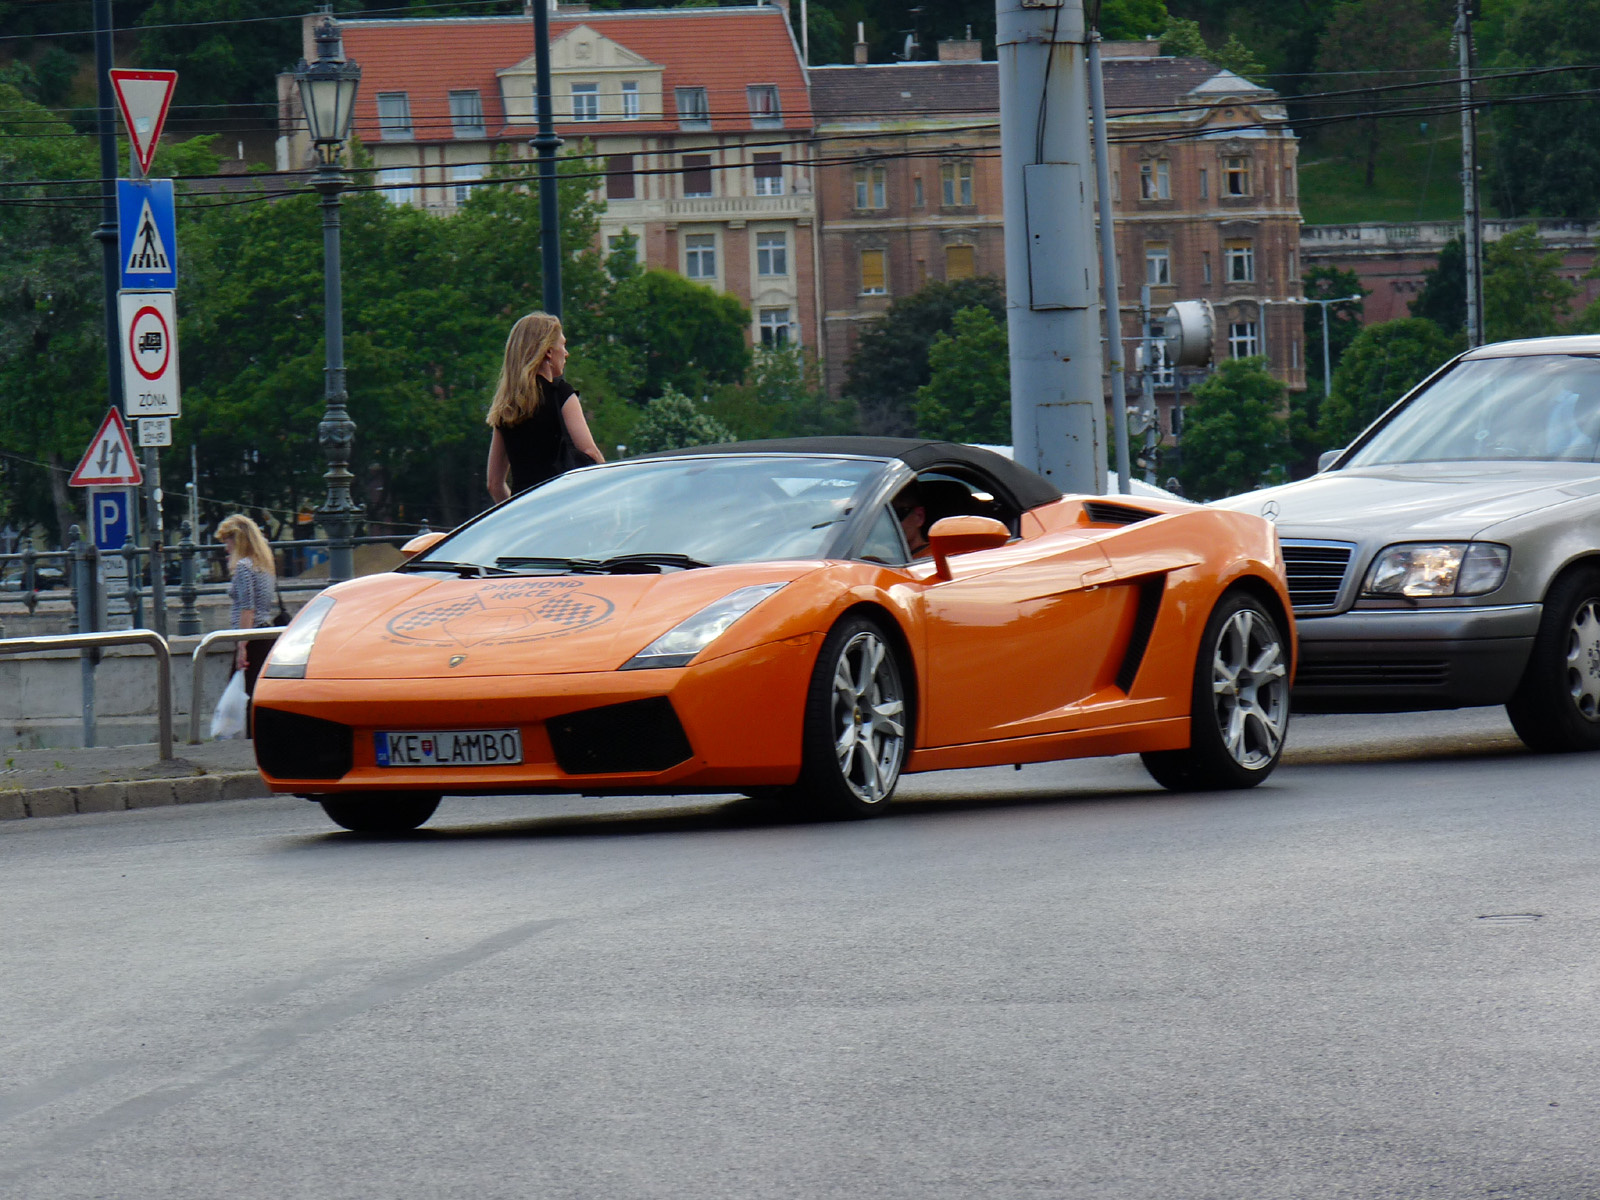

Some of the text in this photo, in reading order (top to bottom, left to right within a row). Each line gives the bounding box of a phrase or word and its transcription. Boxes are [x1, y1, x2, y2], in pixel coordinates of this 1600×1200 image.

[139, 390, 168, 406] ZÓNA
[100, 500, 119, 543] P
[479, 579, 584, 591] DIAMOND
[491, 589, 552, 600] RACE
[389, 733, 517, 762] KE LAMBO
